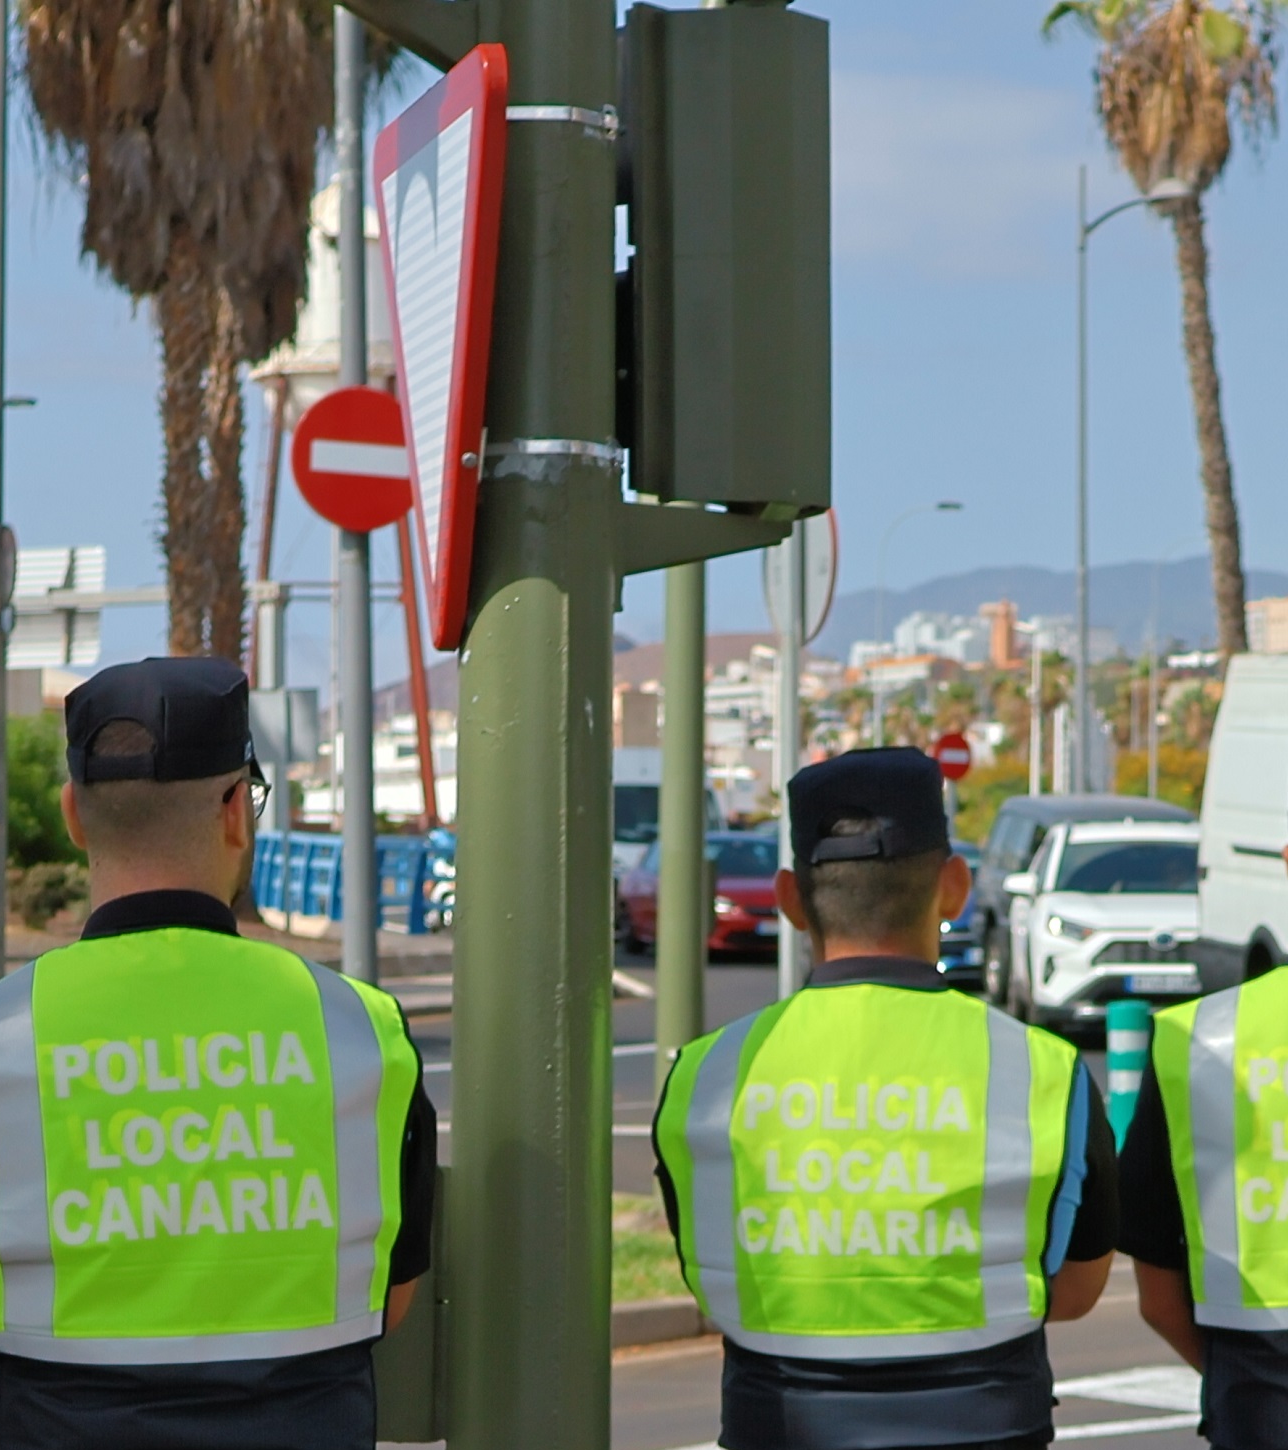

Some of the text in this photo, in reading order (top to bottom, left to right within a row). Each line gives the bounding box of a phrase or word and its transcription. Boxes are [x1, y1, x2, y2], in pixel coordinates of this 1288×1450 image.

[52, 1031, 315, 1098] POLICIA
[743, 1082, 970, 1132] POLICIA
[85, 1109, 294, 1170] LOCAL
[766, 1149, 946, 1195] LOCAL
[52, 1176, 333, 1245] CANARIA
[737, 1205, 979, 1258] CANARIA
